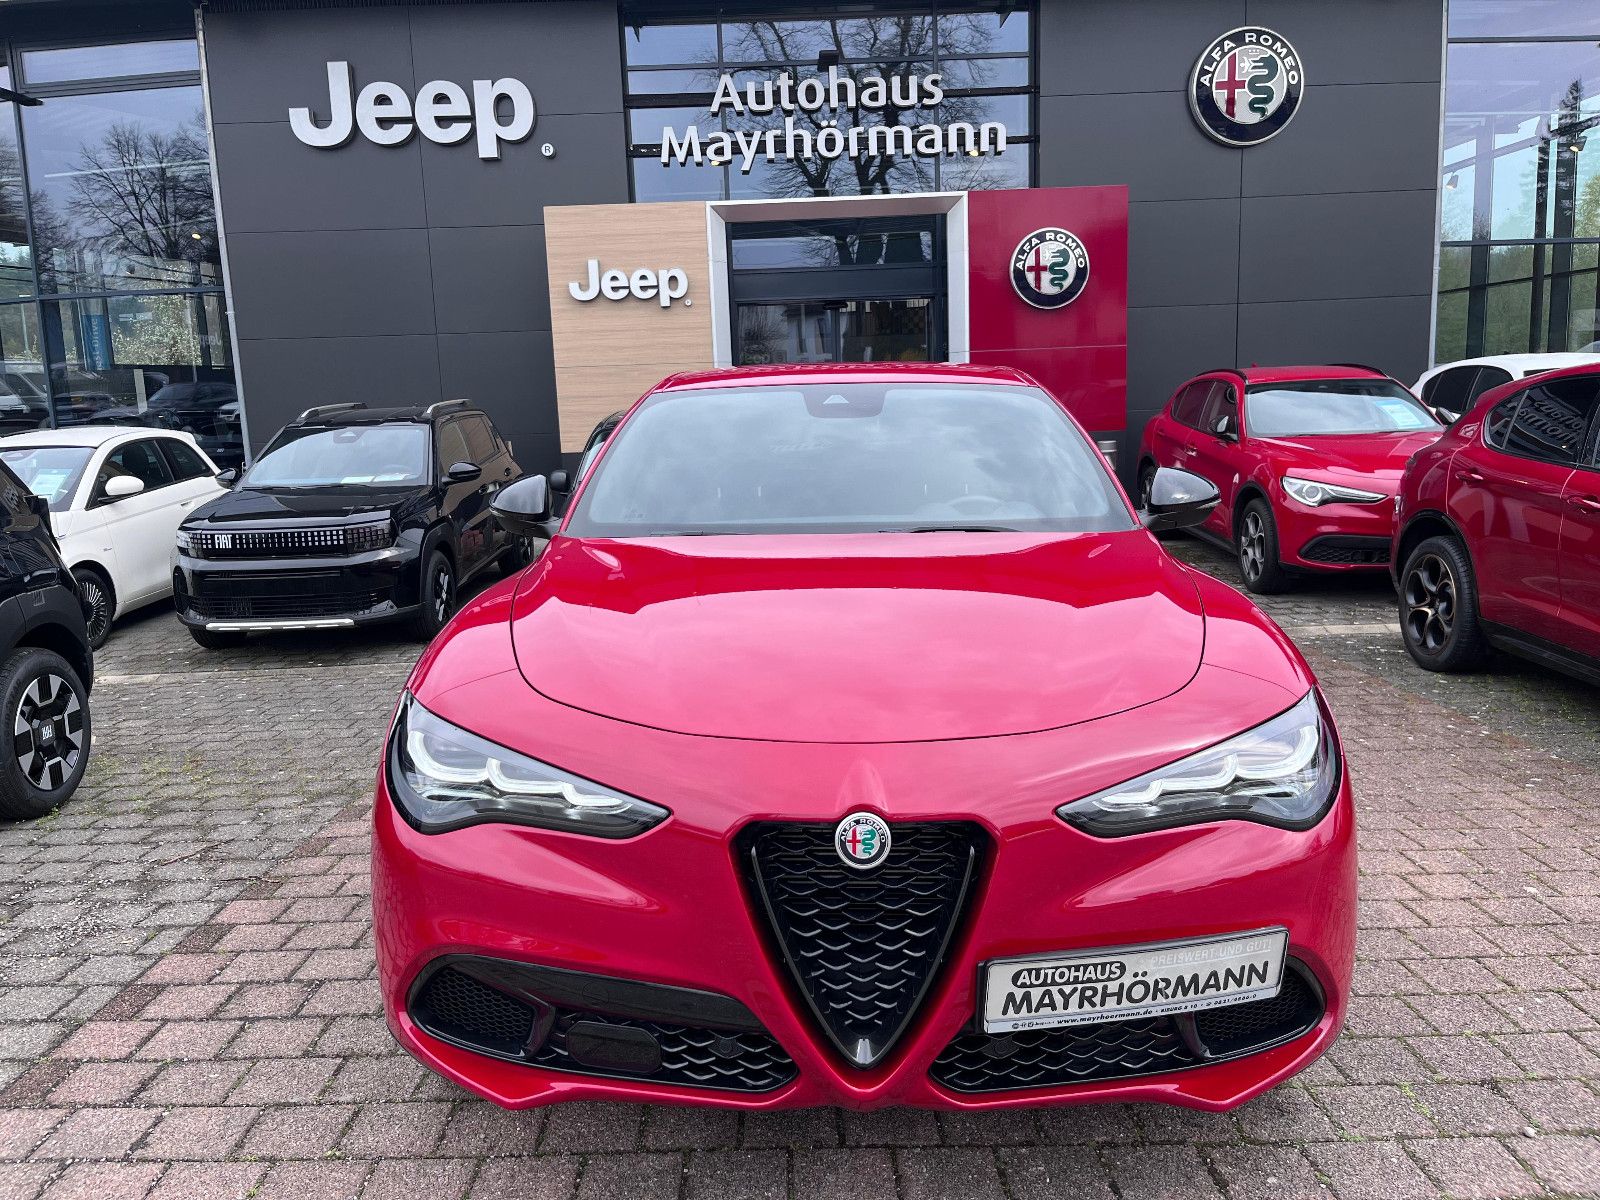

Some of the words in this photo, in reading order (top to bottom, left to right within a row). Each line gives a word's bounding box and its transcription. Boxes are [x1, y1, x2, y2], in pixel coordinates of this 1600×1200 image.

[1199, 39, 1236, 87] ALFA
[1244, 32, 1299, 85] ROMEO
[288, 61, 536, 160] Jeep
[709, 65, 944, 115] Autohaus
[660, 116, 1007, 174] Mayrhörmann
[1016, 237, 1040, 271] ALFA
[1045, 232, 1085, 268] ROMEO
[568, 258, 689, 308] Jeep
[214, 534, 232, 549] FIAT
[841, 821, 857, 842] ALFA
[859, 818, 885, 843] ROMEO
[1219, 944, 1243, 958] UND
[1001, 961, 1269, 1016] MAYRHÖRMANN
[1016, 961, 1121, 987] AUTOHAUS
[1056, 1008, 1153, 1025] www.mayrhoermann.de
